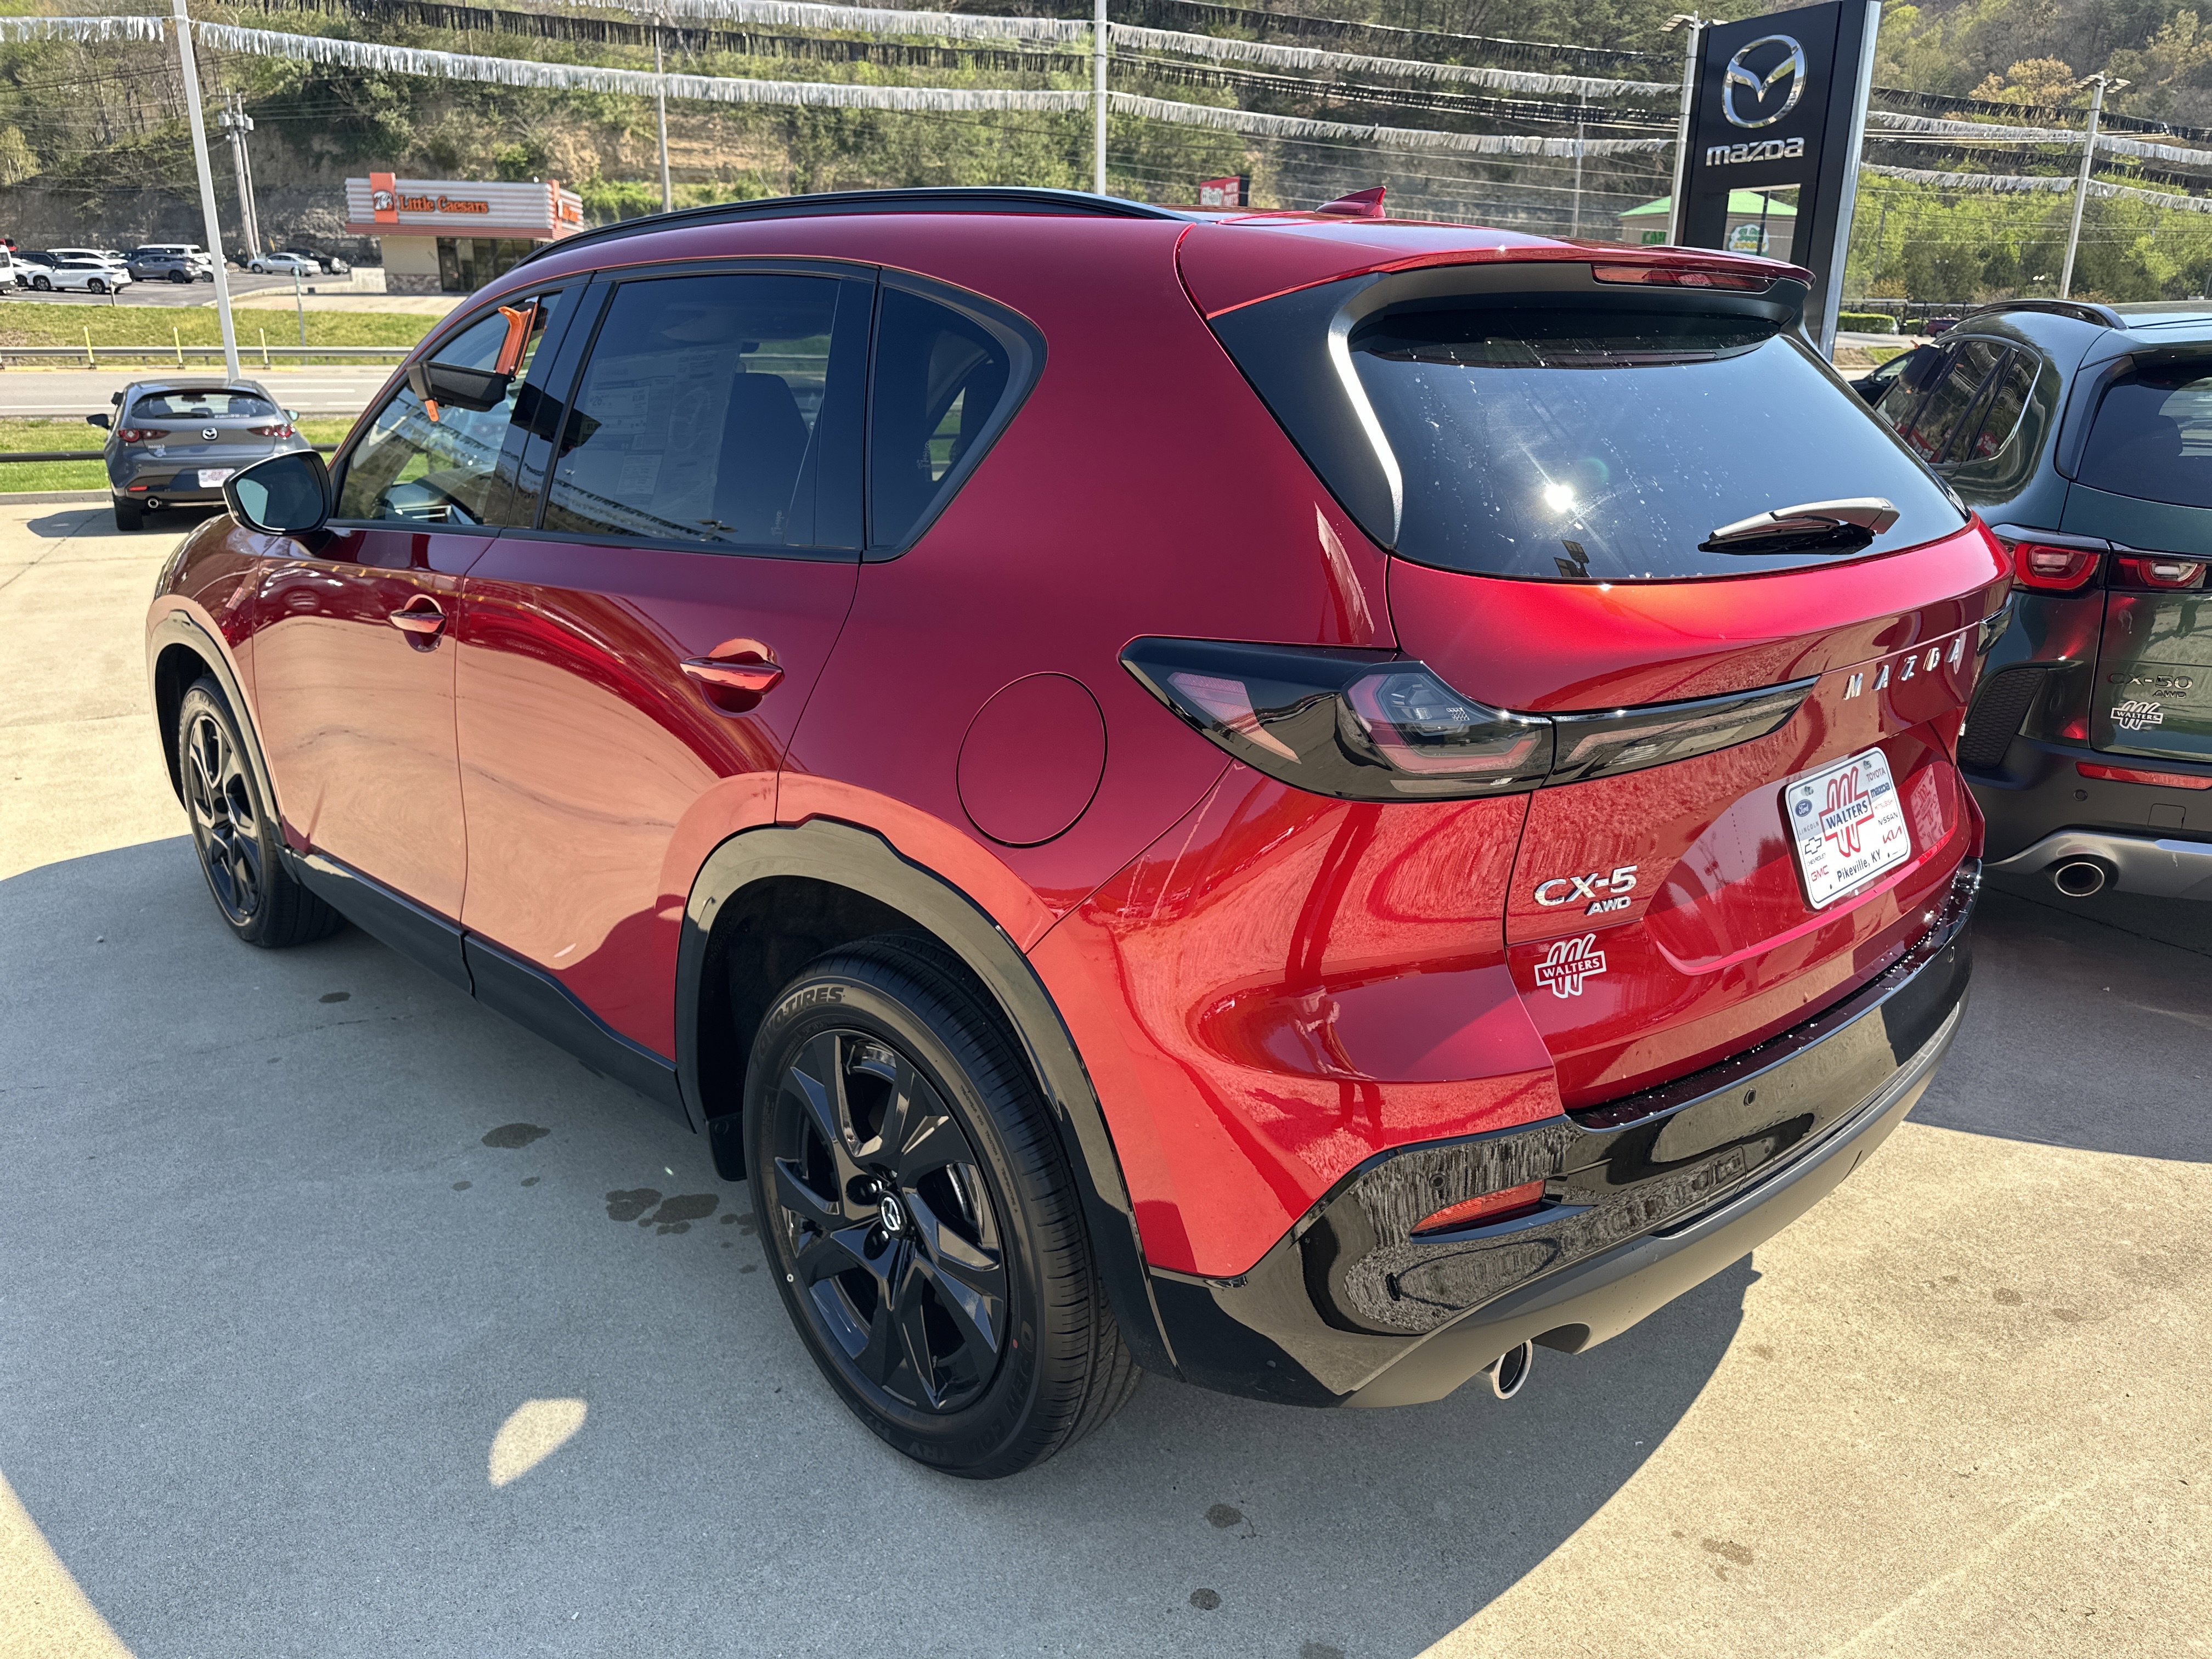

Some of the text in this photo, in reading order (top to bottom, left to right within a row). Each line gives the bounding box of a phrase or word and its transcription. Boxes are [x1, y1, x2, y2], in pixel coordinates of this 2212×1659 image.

[398, 194, 489, 214] Little Caesars
[1843, 638, 1960, 701] MAZDA
[2107, 672, 2193, 690] CX-50
[2152, 690, 2187, 698] AWD
[2116, 710, 2160, 721] WALTERS
[1866, 767, 1886, 783] TOYOTA
[1825, 800, 1869, 830] WALTERS
[1877, 812, 1898, 826] NISSAN
[1799, 820, 1819, 836] LINCOLN
[1810, 864, 1830, 882] GMC
[1836, 858, 1871, 883] Pikeville,
[1871, 848, 1881, 863] KY
[1533, 865, 1638, 906] CX-5
[1584, 895, 1632, 916] AWD
[1542, 957, 1600, 978] WALTERS
[786, 987, 845, 1017] TIRES
